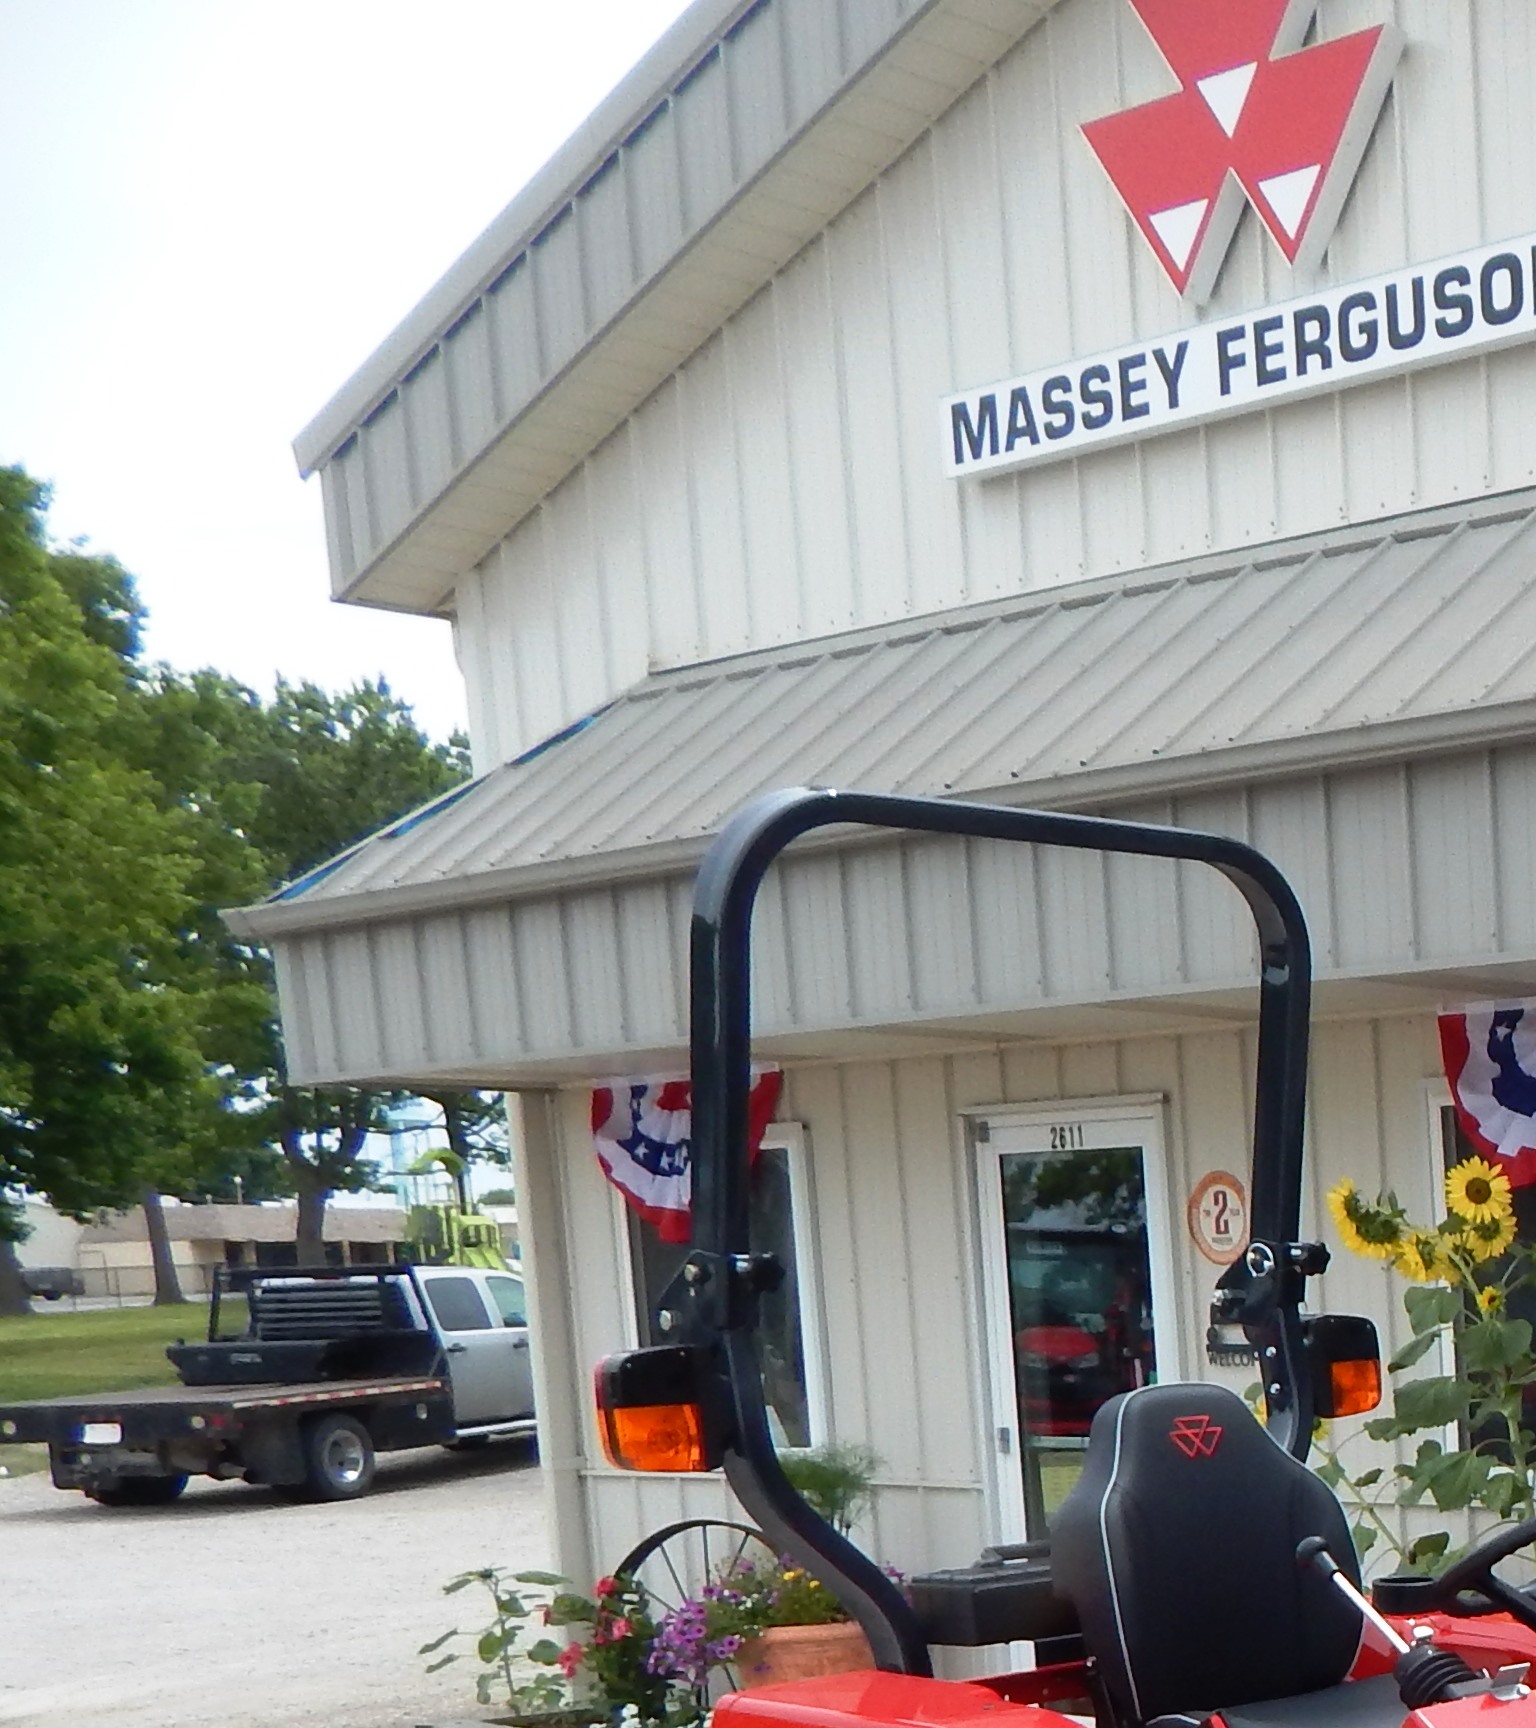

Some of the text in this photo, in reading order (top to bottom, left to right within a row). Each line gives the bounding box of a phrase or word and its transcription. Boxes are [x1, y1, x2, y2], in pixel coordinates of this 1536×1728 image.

[950, 340, 1190, 466] MASSEY
[1050, 1125, 1083, 1149] 2611
[1213, 1190, 1230, 1235] 2
